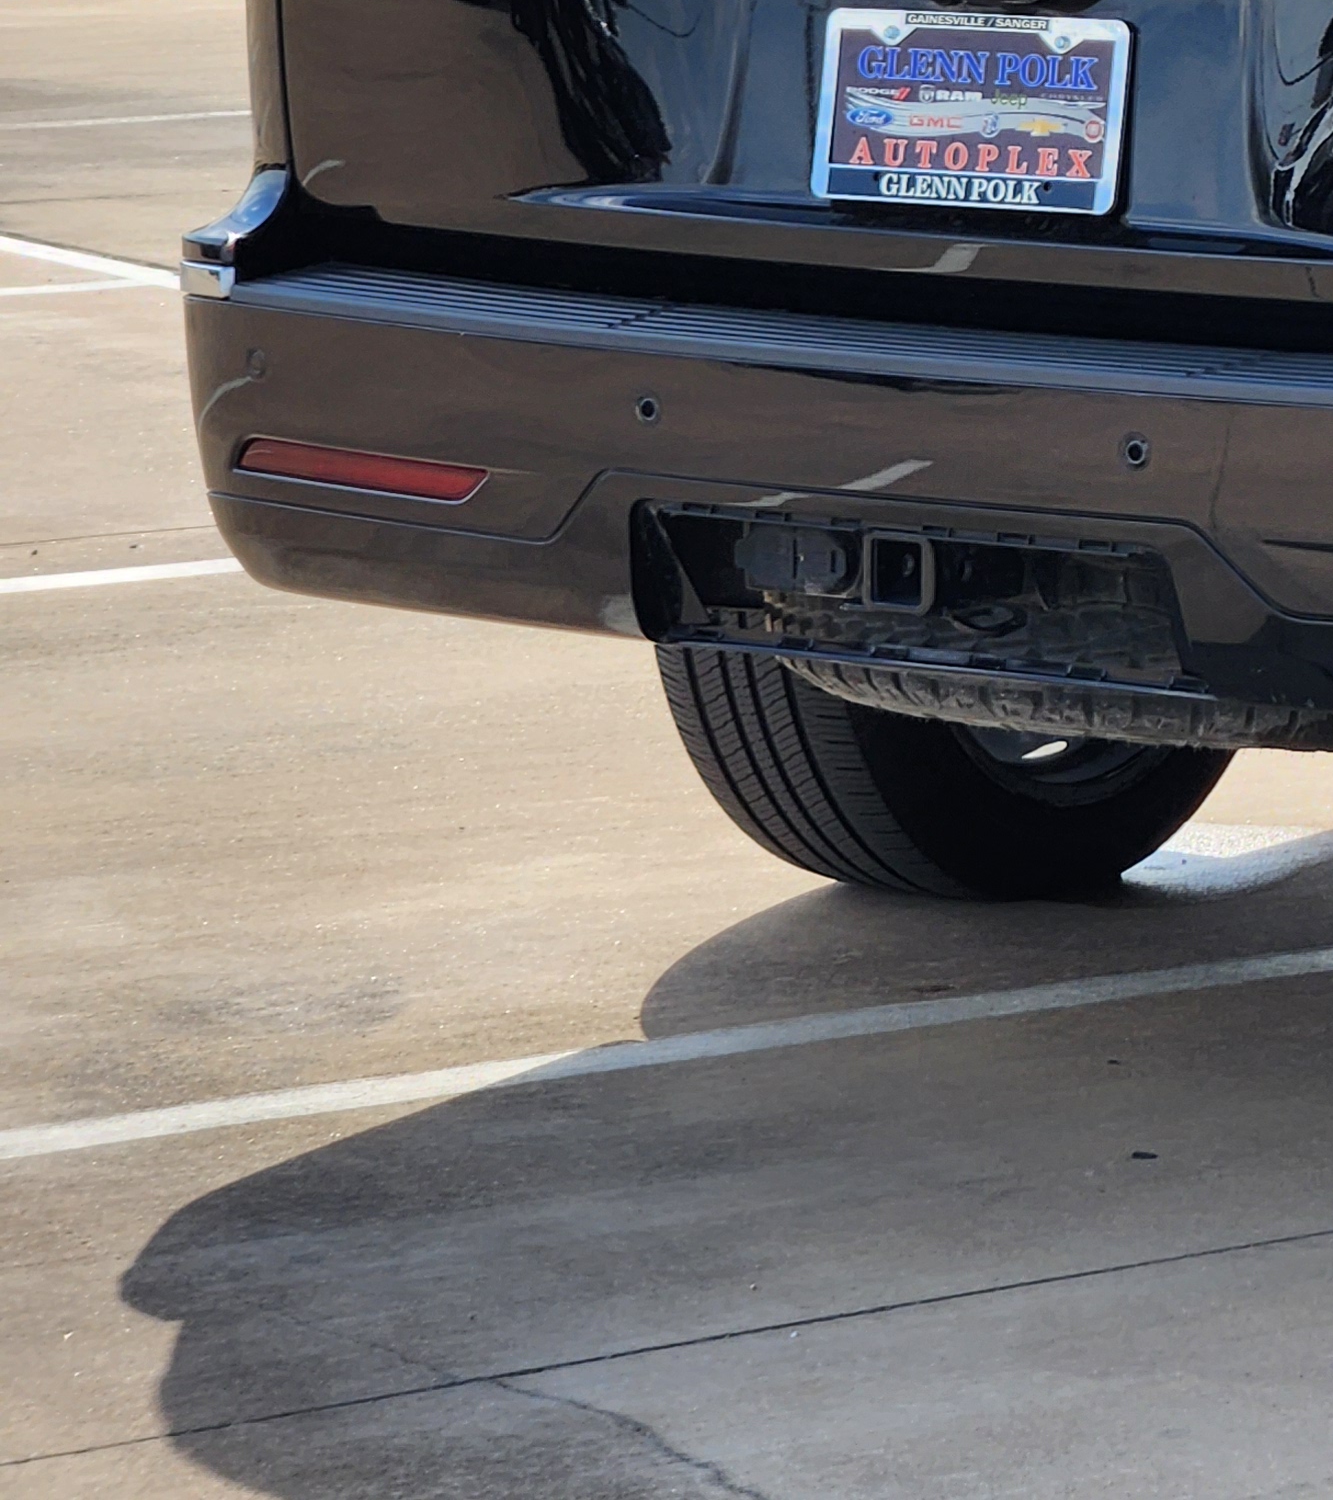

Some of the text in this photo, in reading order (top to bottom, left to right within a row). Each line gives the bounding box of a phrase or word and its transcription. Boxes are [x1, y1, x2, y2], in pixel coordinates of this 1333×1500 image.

[907, 14, 985, 26] GAINESVILLE
[995, 18, 1047, 29] SANGER
[858, 45, 1099, 90] GLENN POLK
[936, 89, 983, 101] RAM
[991, 88, 1028, 110] Jeep
[909, 115, 963, 128] GMC
[849, 136, 1093, 178] AUTOPLEX
[878, 172, 1041, 204] GLENN POLK
